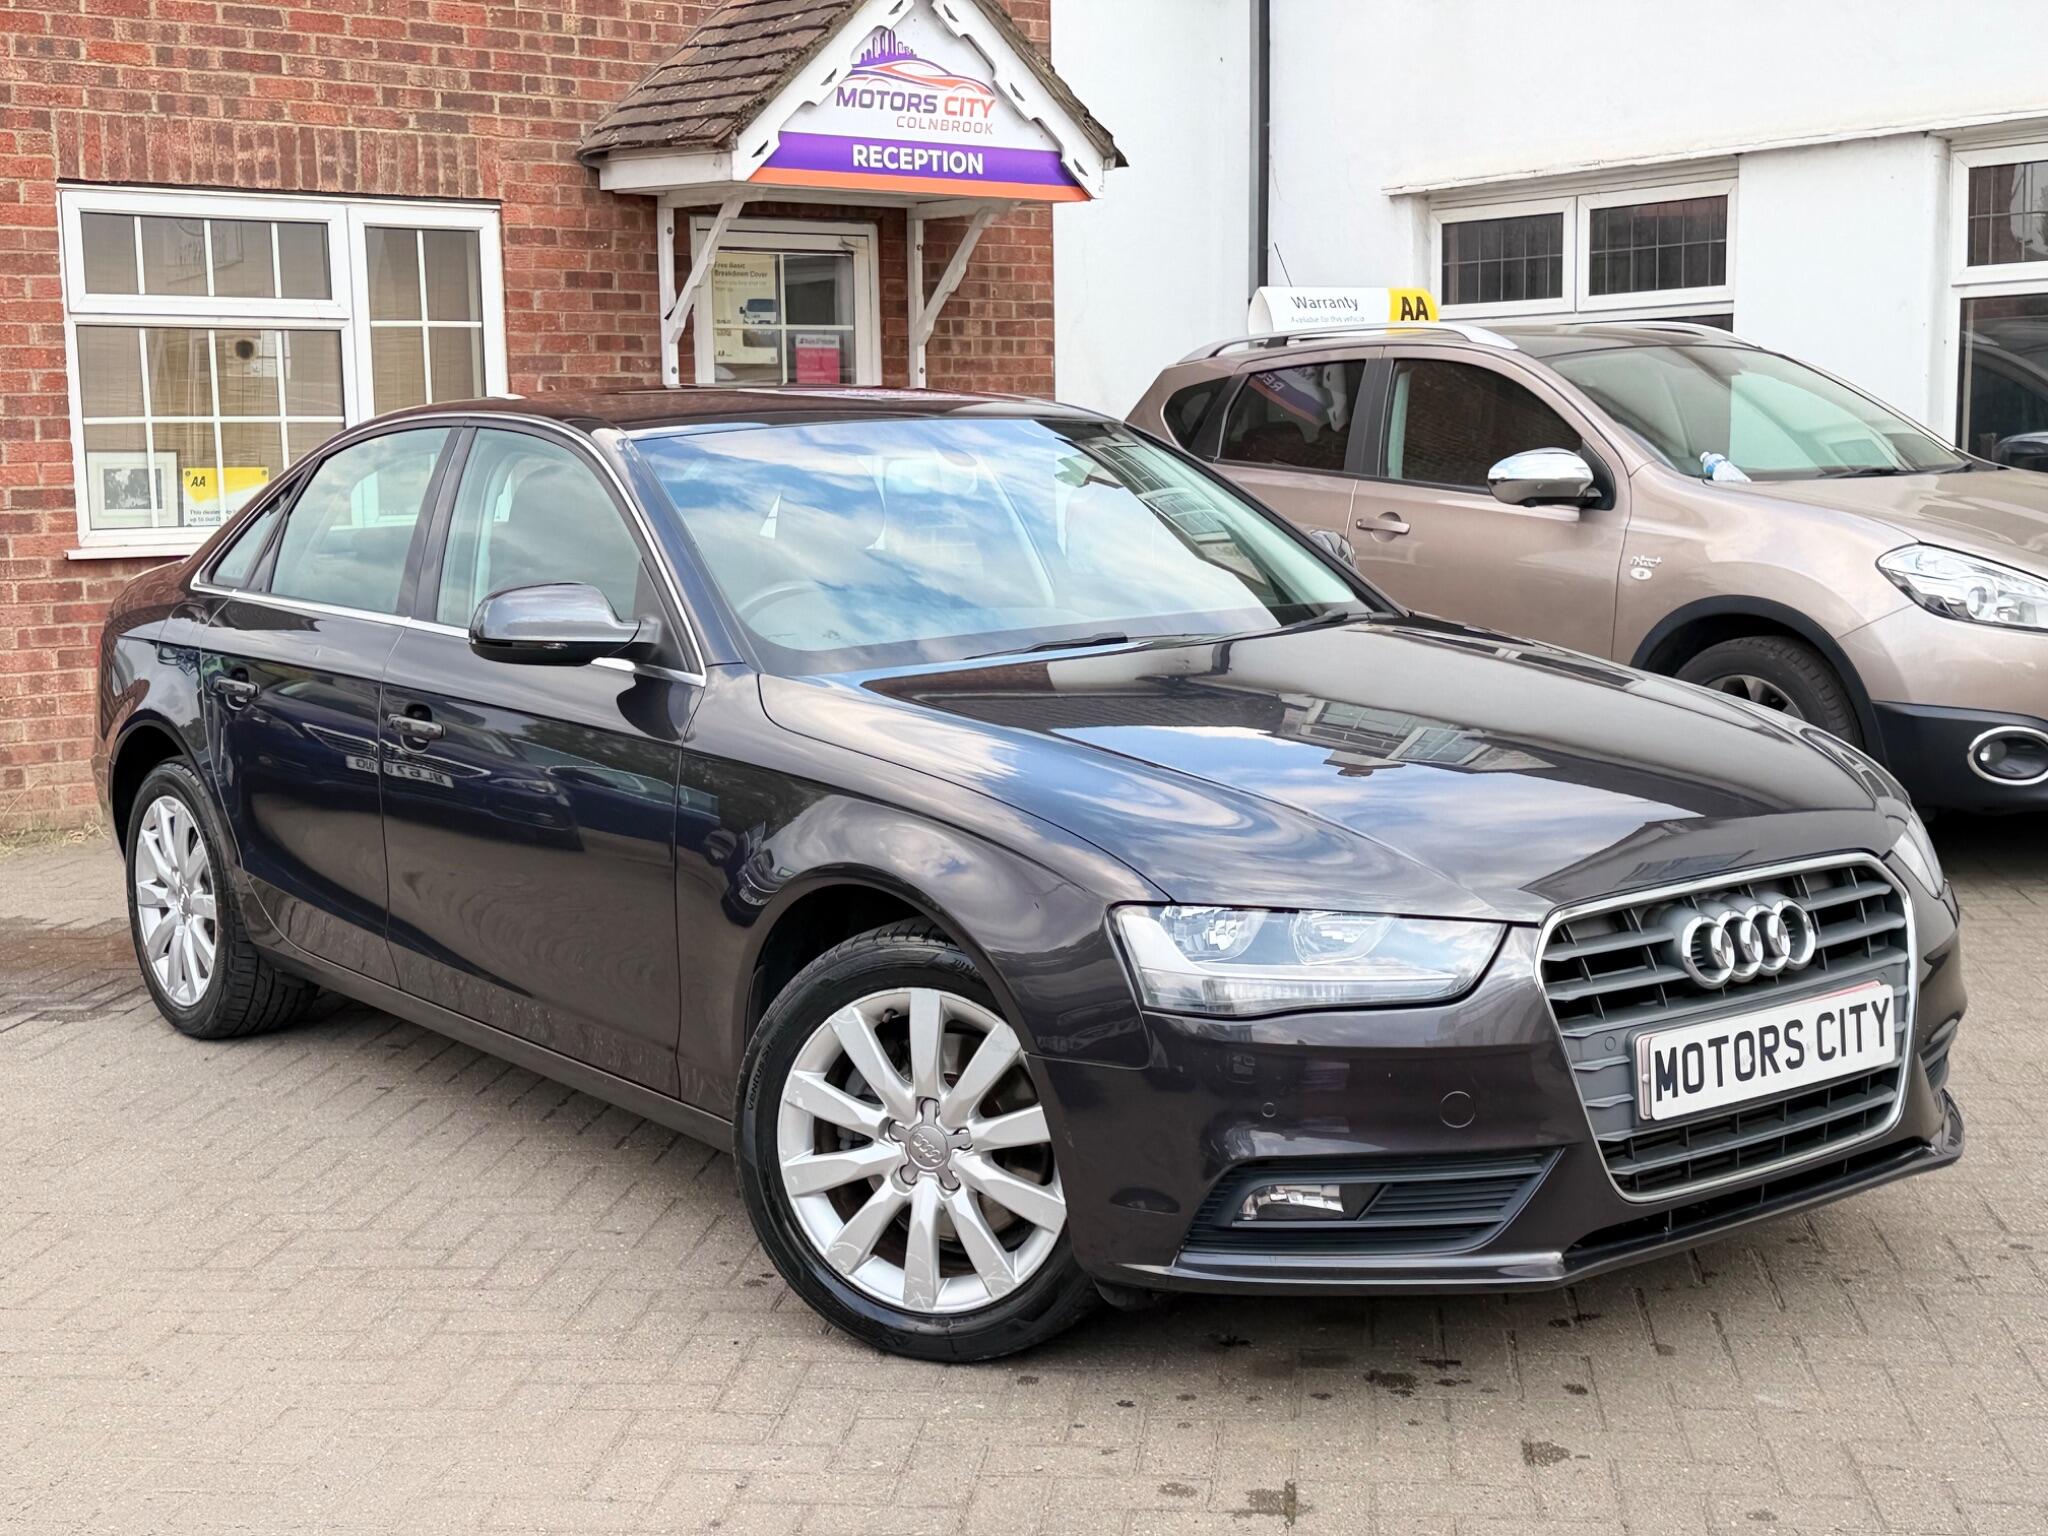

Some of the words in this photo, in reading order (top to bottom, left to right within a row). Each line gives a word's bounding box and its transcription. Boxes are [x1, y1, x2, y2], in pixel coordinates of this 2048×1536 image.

[836, 86, 938, 114] MOTORS
[944, 96, 996, 118] CITY
[896, 116, 993, 135] COLNBROOK
[852, 144, 984, 175] RECEPTION
[1291, 296, 1358, 311] Warranty
[1400, 296, 1429, 321] AA
[191, 476, 206, 487] AA
[1655, 1019, 1804, 1102] MOTORS
[1816, 998, 1890, 1061] CITY
